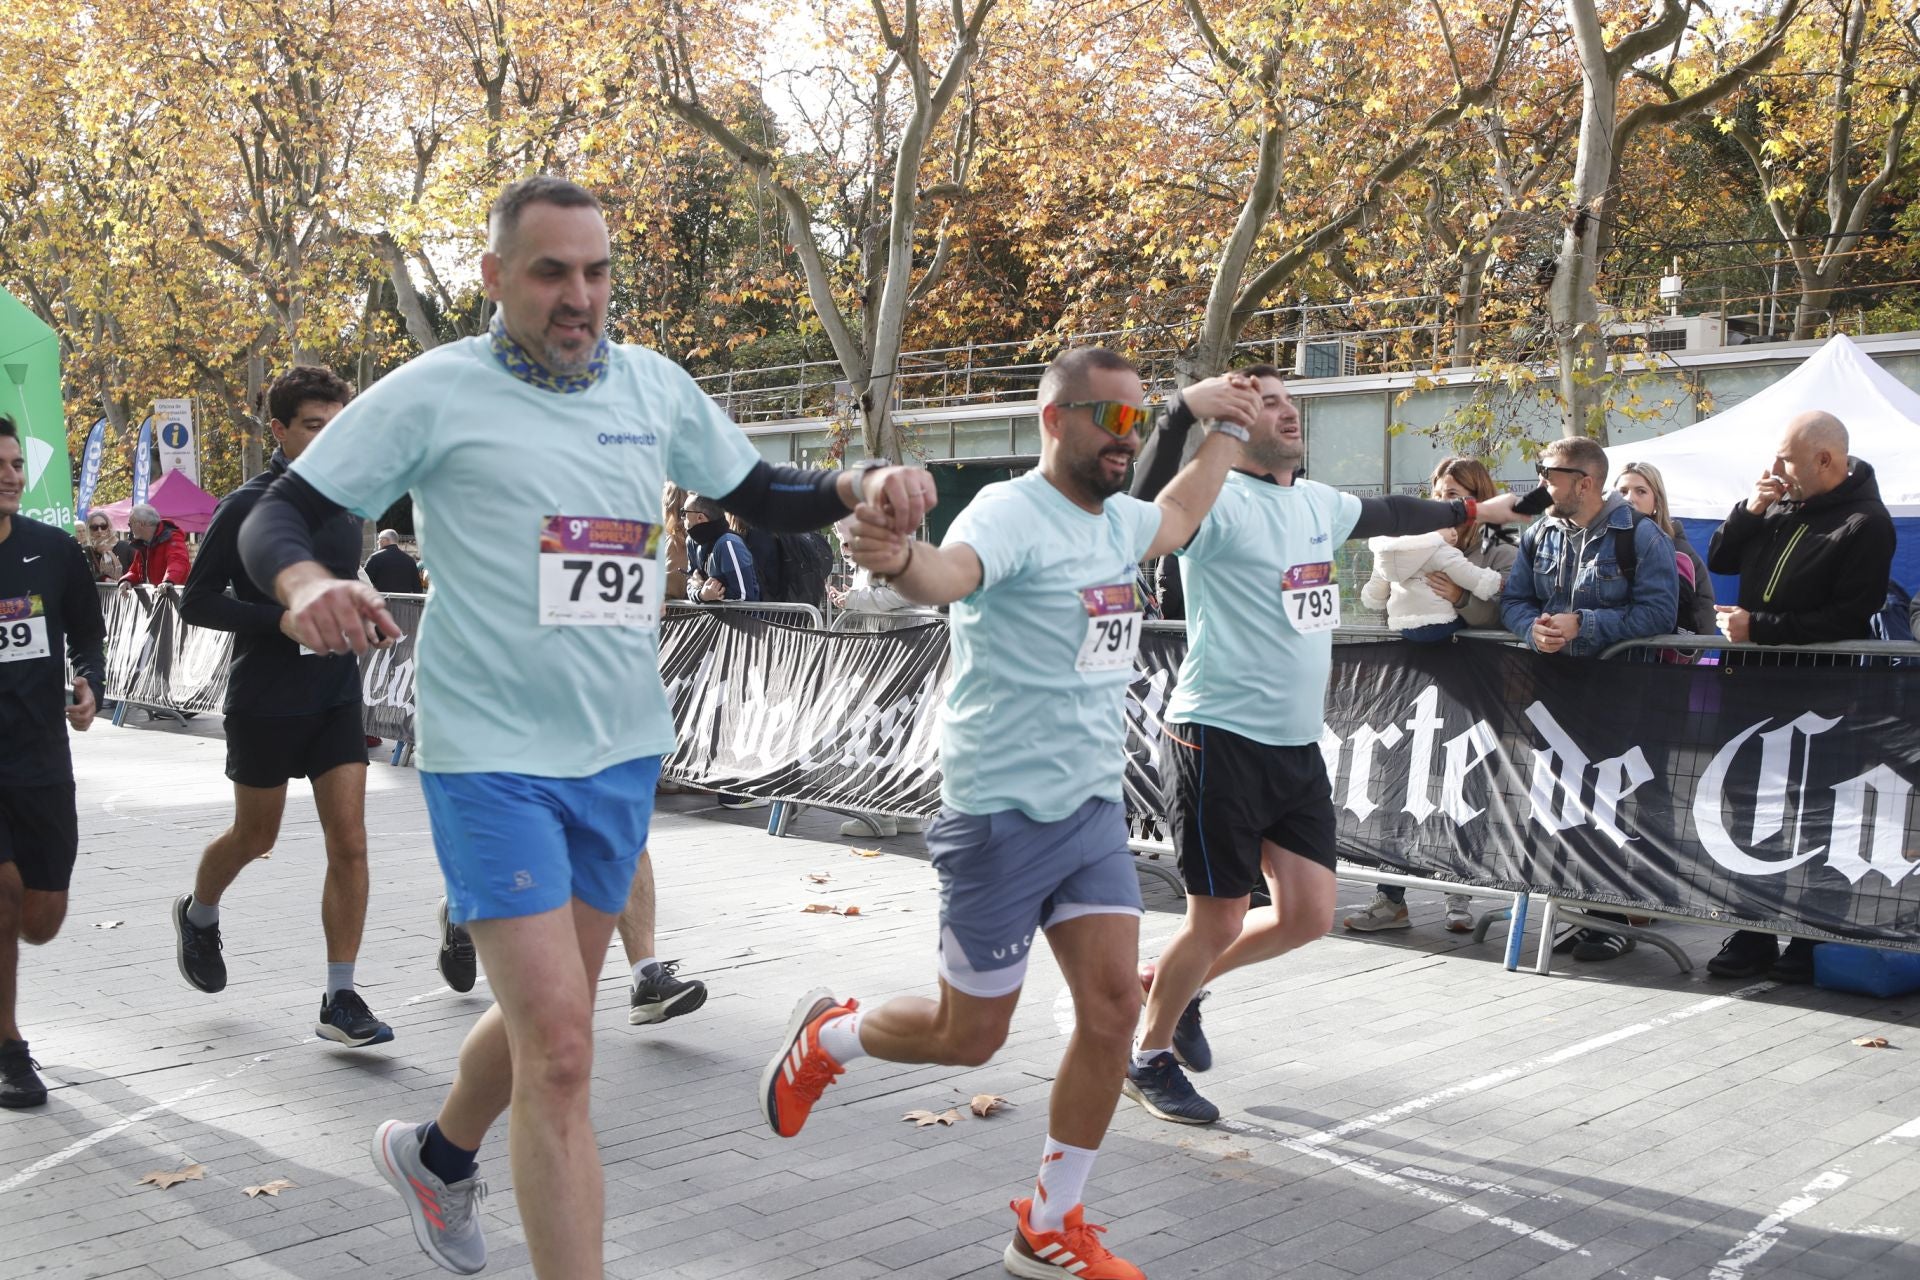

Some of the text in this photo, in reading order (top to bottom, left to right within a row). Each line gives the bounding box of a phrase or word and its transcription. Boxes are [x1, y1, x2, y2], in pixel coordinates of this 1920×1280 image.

[597, 432, 657, 445] OneHealth
[563, 560, 644, 605] 792
[1292, 589, 1333, 621] 793
[1093, 617, 1133, 653] 791
[1524, 700, 1655, 849] de
